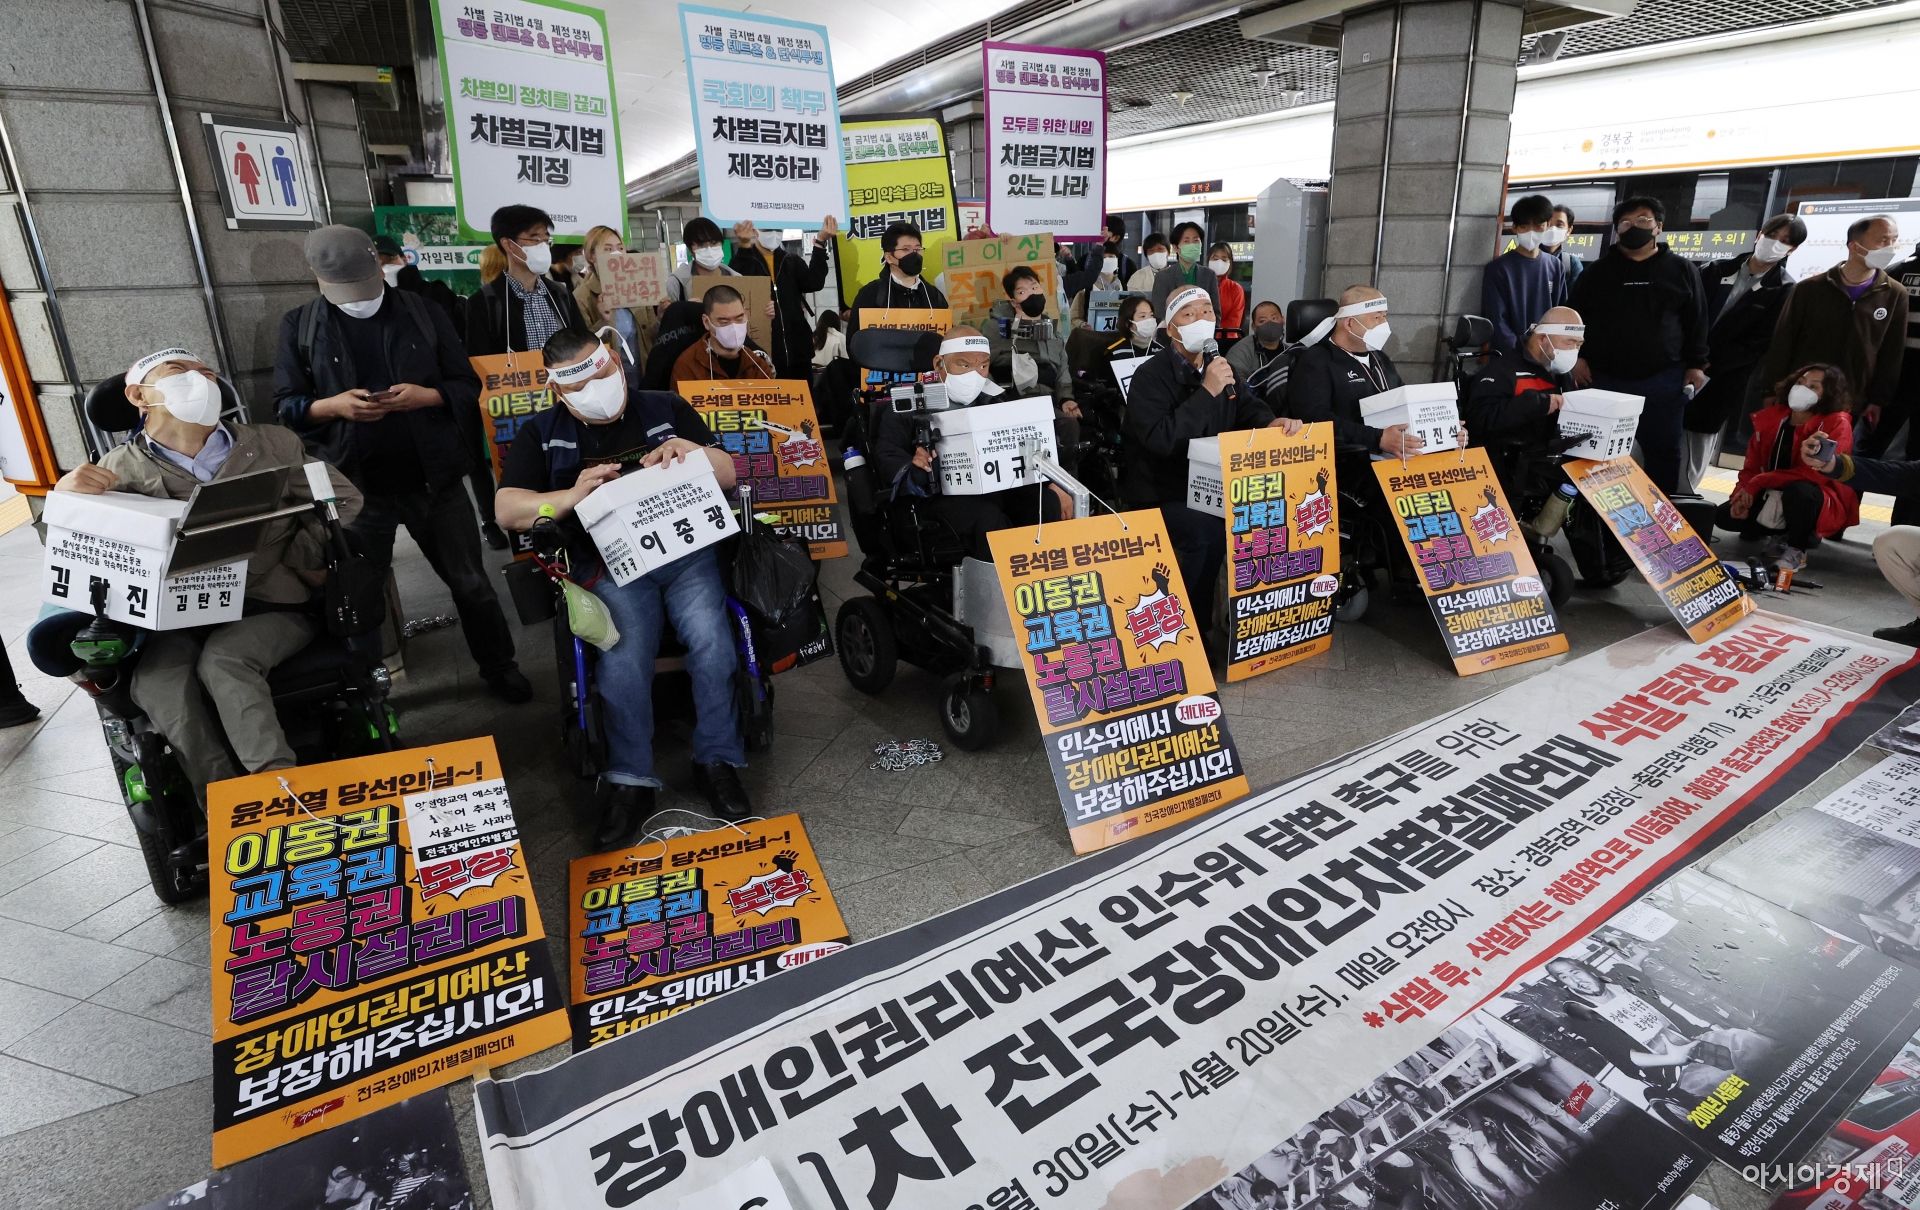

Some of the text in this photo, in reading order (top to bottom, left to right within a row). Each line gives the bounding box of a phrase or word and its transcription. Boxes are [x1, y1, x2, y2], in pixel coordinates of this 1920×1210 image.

[463, 6, 591, 42] 차별 금지법 4월 제정 쟁취
[705, 25, 722, 36] 차별
[729, 28, 754, 42] 금지법
[537, 33, 549, 49] &
[551, 36, 603, 60] 단식투쟁
[460, 77, 606, 115] 차별의 정치를 끊고
[703, 79, 825, 115] 국회의 책무
[471, 113, 603, 155] 차별금지법
[713, 116, 826, 148] 차별금지법
[1002, 117, 1093, 134] 모두를 위한 내일
[1601, 131, 1634, 147] 경복궁
[518, 155, 570, 185] 제정
[728, 153, 819, 181] 제정하라
[1001, 143, 1094, 169] 차별금지법
[881, 184, 917, 203] 약속을
[1008, 174, 1088, 197] 있는 나라
[947, 234, 1044, 267] 더 이 상
[1567, 235, 1594, 247] 주의!
[1711, 232, 1745, 245] 주의!
[420, 251, 465, 264] 자일리톨
[608, 256, 657, 281] 인수위
[486, 370, 531, 391] 윤석열
[488, 388, 554, 418] 이동권
[691, 393, 804, 408] 윤석열 당선인님~!
[1229, 442, 1328, 472] 윤석열 당선인님~!
[1230, 471, 1283, 505] 이동권
[1389, 464, 1489, 493] 윤석열 당선인님~!
[1593, 482, 1636, 512] 이동권
[631, 507, 675, 529] 장애인권리예산을
[1231, 499, 1285, 534] 교육권
[1295, 497, 1332, 536] 보장
[1395, 490, 1452, 518] 이동권
[1610, 503, 1654, 537] 교육권
[1655, 502, 1680, 533] 보장
[1404, 512, 1463, 542] 교육권
[1472, 507, 1511, 541] 보장
[99, 538, 136, 554] 인수위원회는
[1009, 533, 1162, 577] 윤석열 당선인님~!
[1232, 526, 1286, 561] 노동권
[1414, 534, 1472, 565] 노동권
[52, 547, 151, 579] 장애인권리예산을 약속해주십시오!
[1234, 546, 1322, 589] 탈시설권리
[1422, 552, 1519, 590] 탈시설권리
[1015, 571, 1101, 616] 이동권
[1237, 578, 1337, 618] 인수위에서 제대로
[1437, 580, 1543, 616] 인수위에서 제대로
[1665, 565, 1727, 607] 장애인권리예산
[1679, 581, 1740, 623] 보장해주십시오!
[1023, 604, 1113, 652] 교육권
[1127, 592, 1184, 649] 보장
[1237, 598, 1332, 640] 장애인권리예산
[1444, 597, 1546, 634] 장애인권리예산
[1235, 615, 1332, 661] 보장해주십시오!
[1453, 615, 1556, 654] 보장해주십시오!
[1033, 637, 1123, 687] 노동권
[1044, 658, 1184, 723] 탈시설권리
[1057, 701, 1218, 762] 인수위에서 제대로
[1064, 724, 1221, 792] 장애인권리예산
[231, 761, 483, 828] 윤석열 당선인님~!
[1075, 748, 1235, 821] 보장해주십시오!
[473, 802, 497, 814] 추락
[1144, 789, 1223, 824] 전국장애인차별철폐연대
[226, 806, 392, 874] 이동권
[429, 822, 477, 839] 서울시는
[586, 830, 792, 886] 윤석열 당선인님~!
[1429, 722, 1792, 989] 후, 삭발자는 혜화역으로 이동하여, 혜화역 출근선전전
[224, 845, 397, 923] 교육권
[581, 868, 698, 911] 이동권
[729, 871, 810, 917] 보장
[963, 733, 1623, 1134] 전국장애인차별철폐연대
[1578, 662, 1740, 746] 삭발투쟁
[1225, 983, 1349, 1066] 20일(수),
[1334, 945, 1400, 992] 매일
[1385, 898, 1474, 959] 오전8시
[1516, 817, 1596, 868] 경복궁역
[1677, 735, 1719, 756] 방향
[225, 886, 403, 971] 노동권
[581, 889, 703, 937] 교육권
[582, 913, 708, 964] 노동권
[585, 919, 795, 994] 탈시설권리
[230, 895, 520, 1022] 탈시설권리
[589, 916, 1111, 1208] 장애인권리예산
[1098, 842, 1269, 940] 인수위
[1244, 800, 1358, 862] 답변
[1331, 749, 1460, 813] 촉구를
[1436, 717, 1522, 759] 위한
[589, 959, 766, 1027] 인수위에서
[232, 950, 531, 1075] 장애인권리예산
[232, 977, 545, 1117] 보장해주십시오!
[356, 1034, 516, 1103] 전국장애인차별철폐연대
[1686, 1073, 1750, 1130] 2001년 서울역
[1718, 1110, 1755, 1147] 활동가들이
[1739, 1135, 1765, 1159] 박경석
[1757, 1117, 1782, 1140] 대표가
